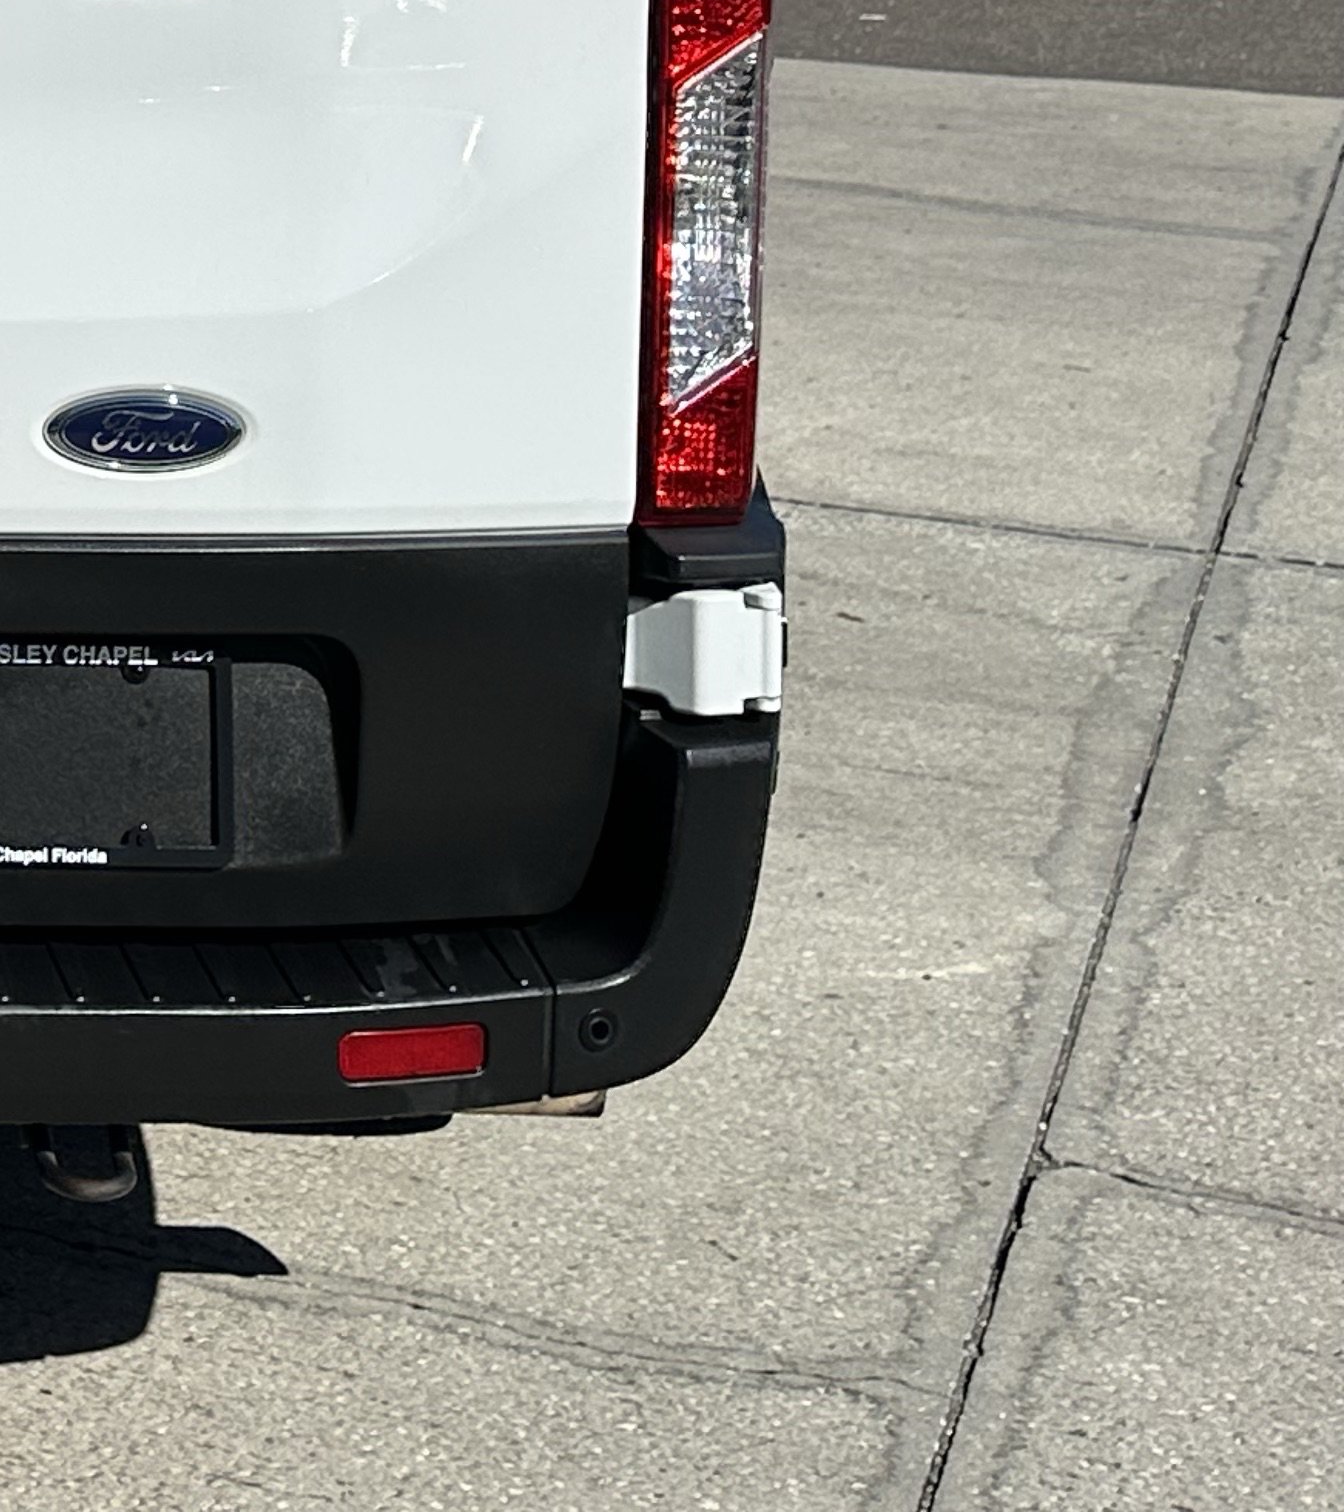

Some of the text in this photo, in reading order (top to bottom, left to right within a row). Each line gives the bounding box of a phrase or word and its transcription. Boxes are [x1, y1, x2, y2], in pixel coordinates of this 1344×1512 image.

[91, 409, 201, 453] Ford
[63, 645, 159, 666] CHAPEL
[51, 847, 108, 864] Florida
